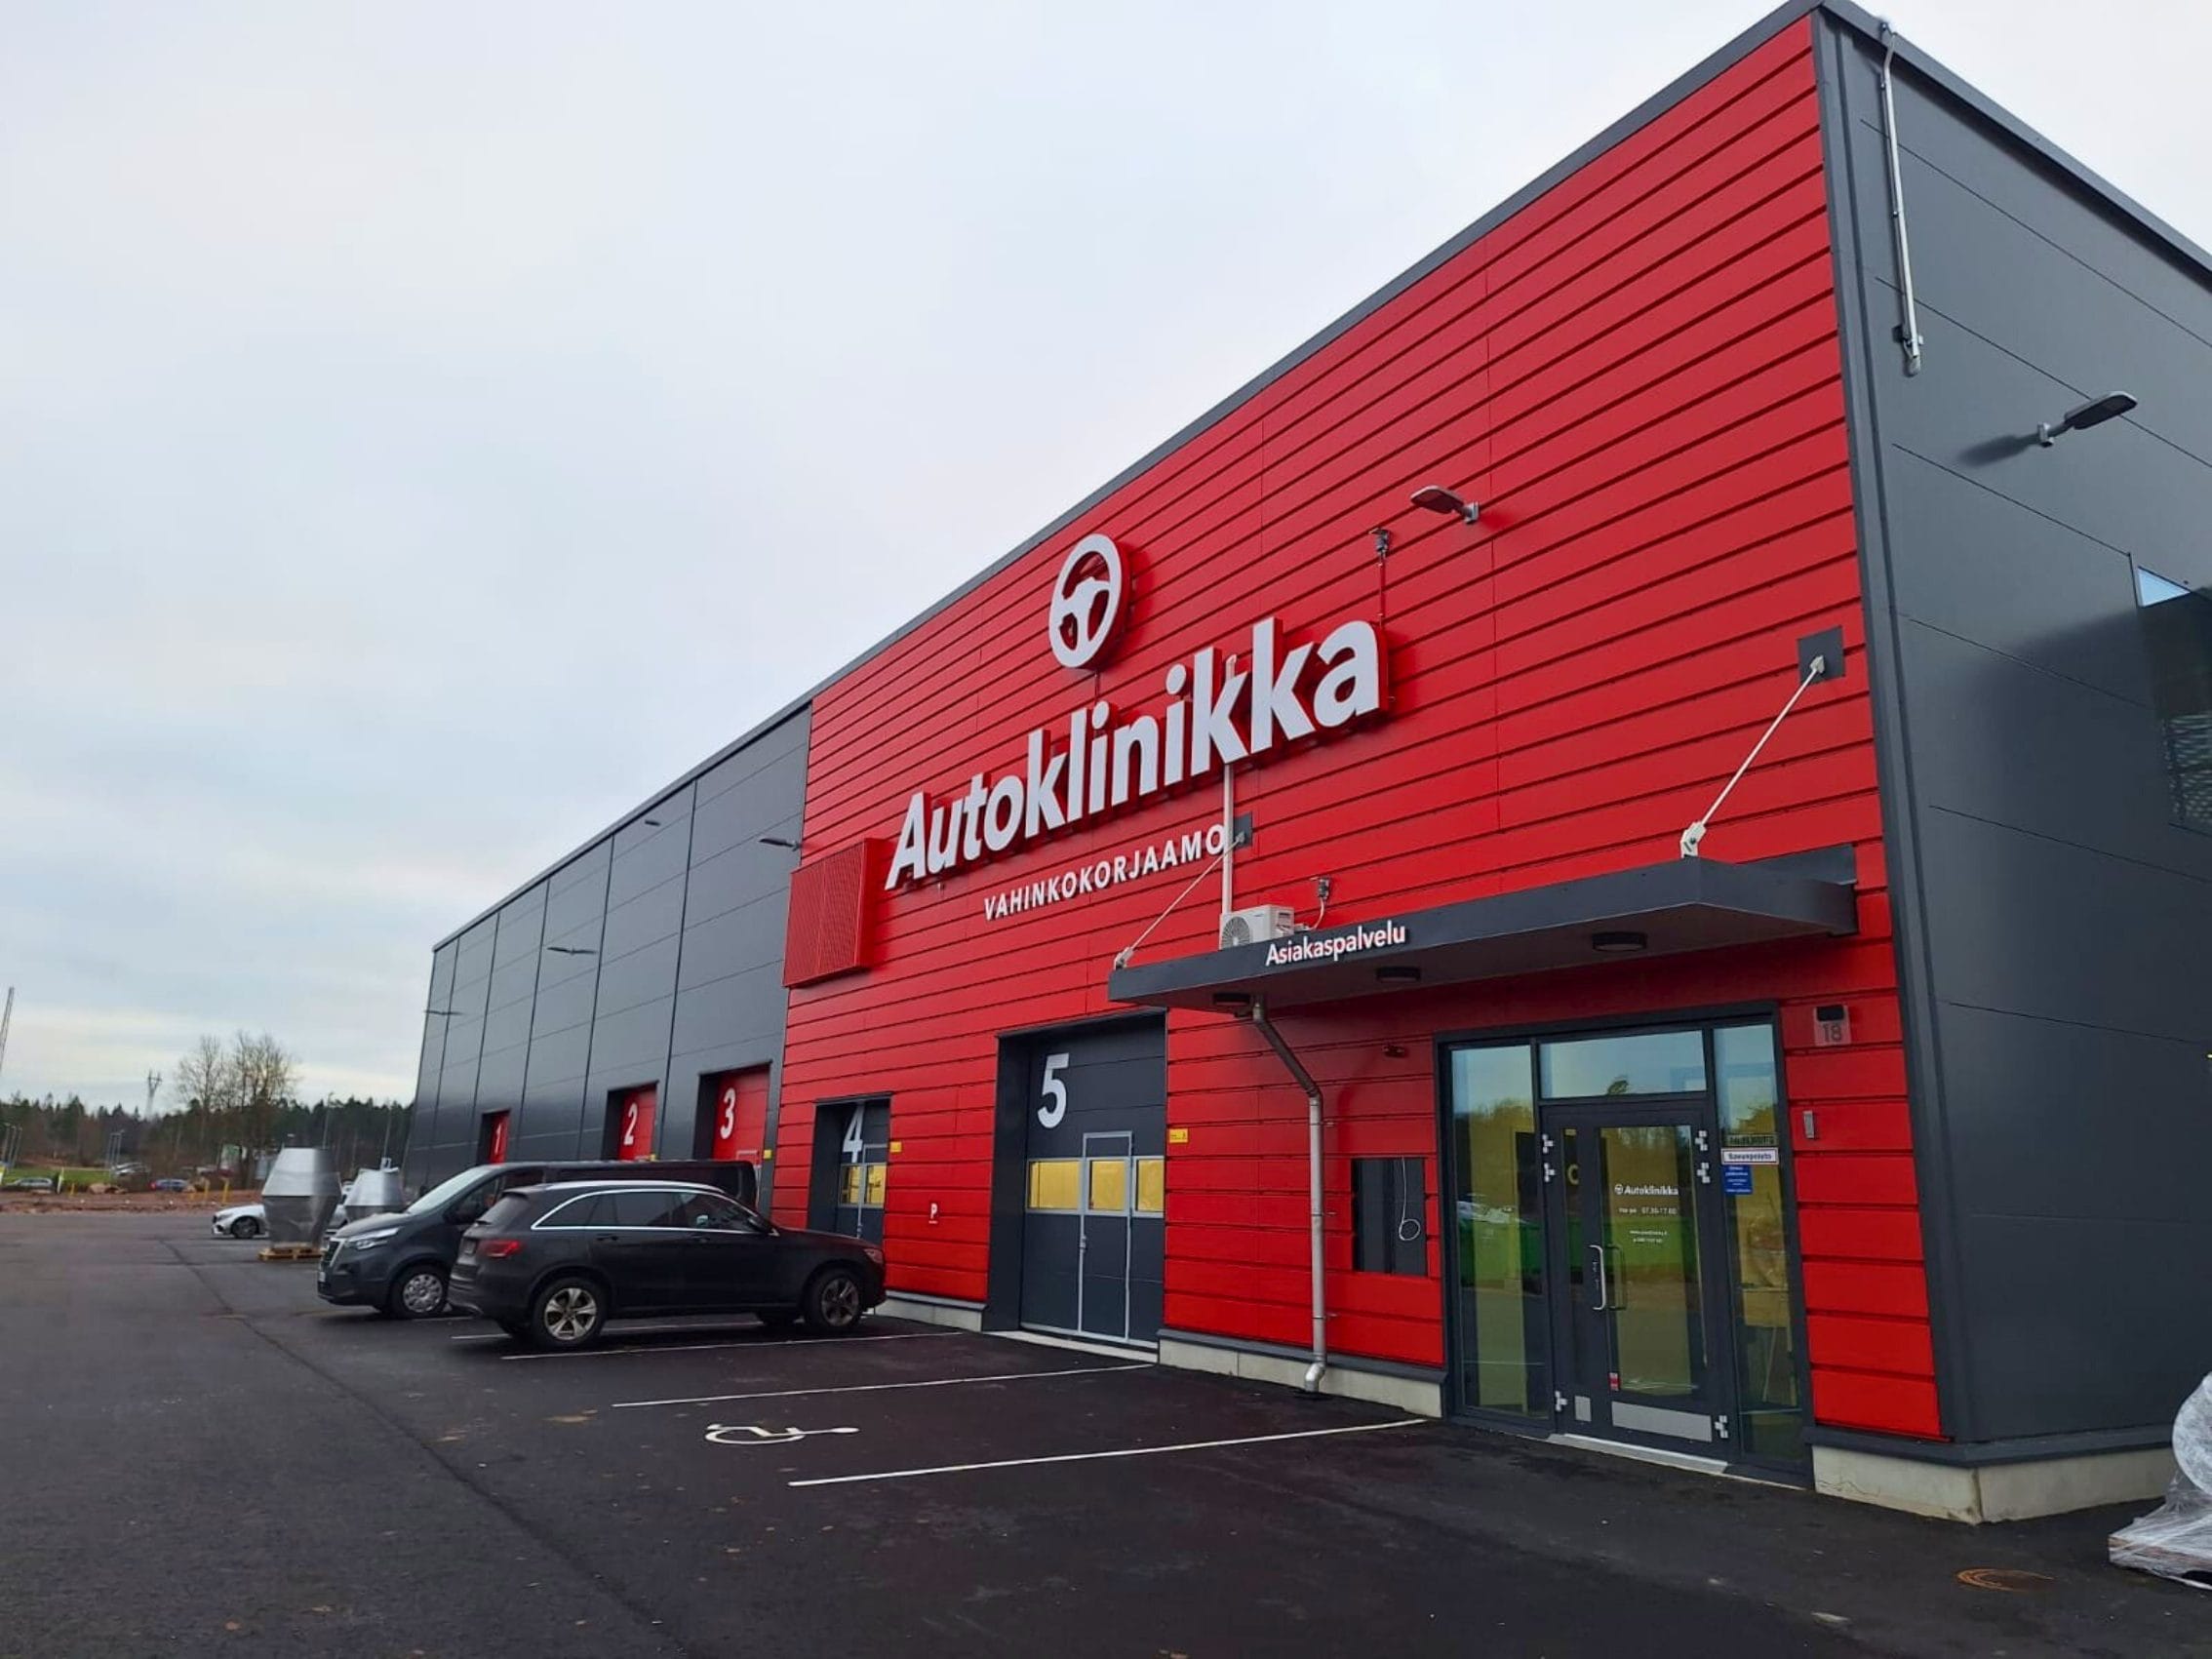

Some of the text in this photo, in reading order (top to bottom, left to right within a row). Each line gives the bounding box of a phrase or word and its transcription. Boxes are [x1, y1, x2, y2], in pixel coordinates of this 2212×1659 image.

[885, 616, 1381, 890] Autoklinikka
[984, 824, 1227, 922] VAHINKOKORJAAMO
[1265, 920, 1406, 967] Asiakaspalvelu
[1822, 1023, 1842, 1043] 18
[720, 1087, 736, 1139] 3
[1037, 1052, 1070, 1129] 5
[494, 1123, 502, 1155] 1
[623, 1102, 639, 1146] 2
[842, 1100, 866, 1164] 4
[929, 1203, 938, 1219] P
[1623, 1184, 1679, 1197] Autoklinikka
